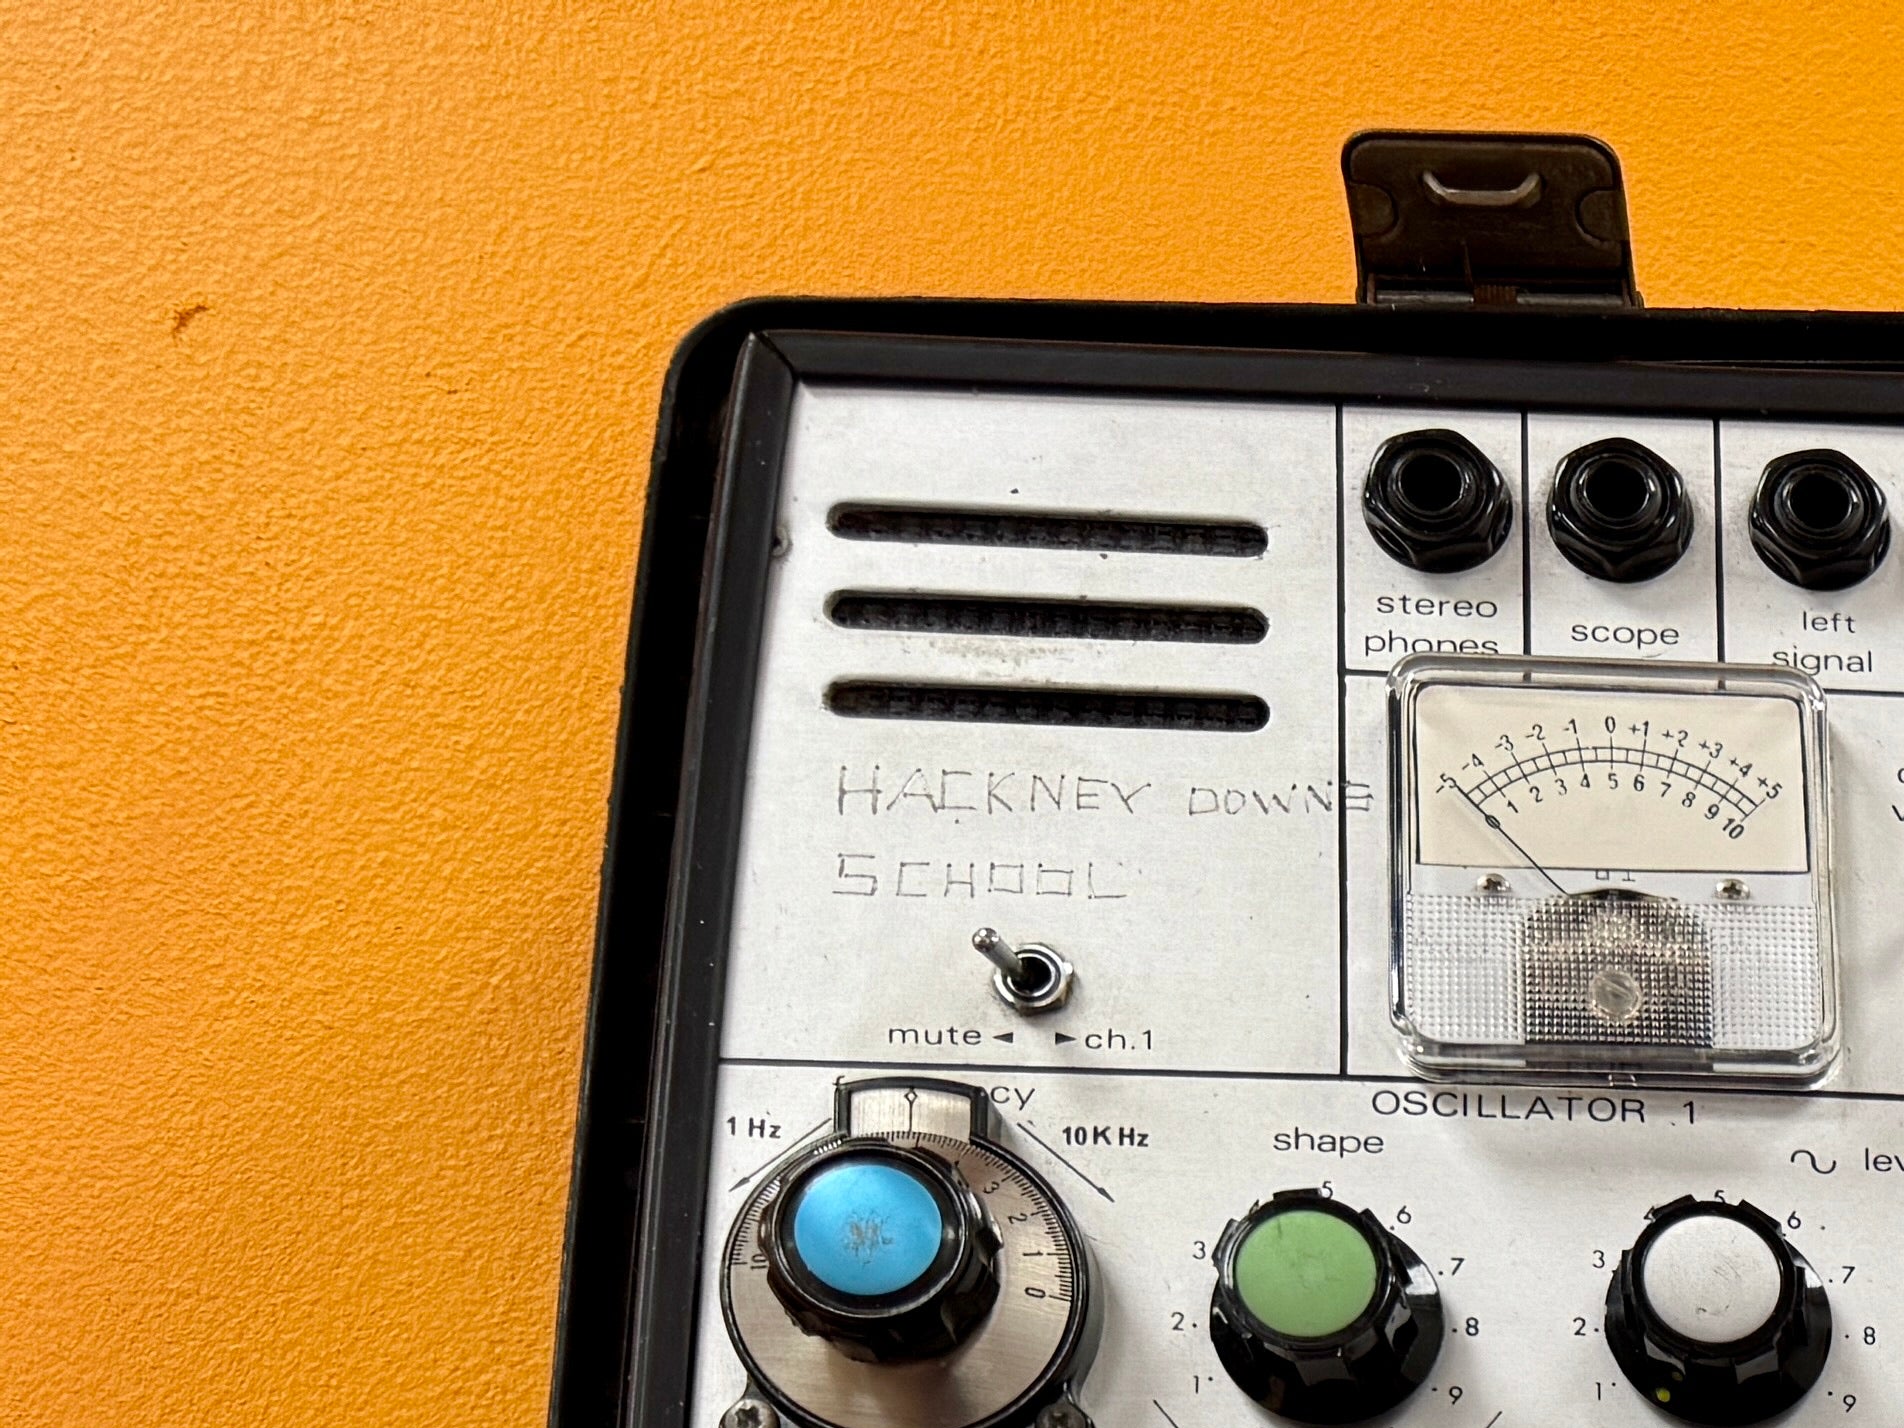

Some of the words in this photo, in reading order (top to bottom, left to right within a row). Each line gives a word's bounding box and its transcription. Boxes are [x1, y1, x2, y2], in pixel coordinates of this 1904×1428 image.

[1375, 593, 1499, 619] stereo
[1801, 609, 1857, 635] left
[1570, 623, 1681, 651] scope
[1770, 644, 1875, 676] signal
[836, 763, 1153, 817] HACKNEY
[830, 851, 1129, 901] SCHOOL
[887, 1025, 983, 1047] mute
[1369, 1088, 1648, 1127] OSCILLATOR
[1681, 1097, 1696, 1126] 1
[1272, 1125, 1385, 1160] shape
